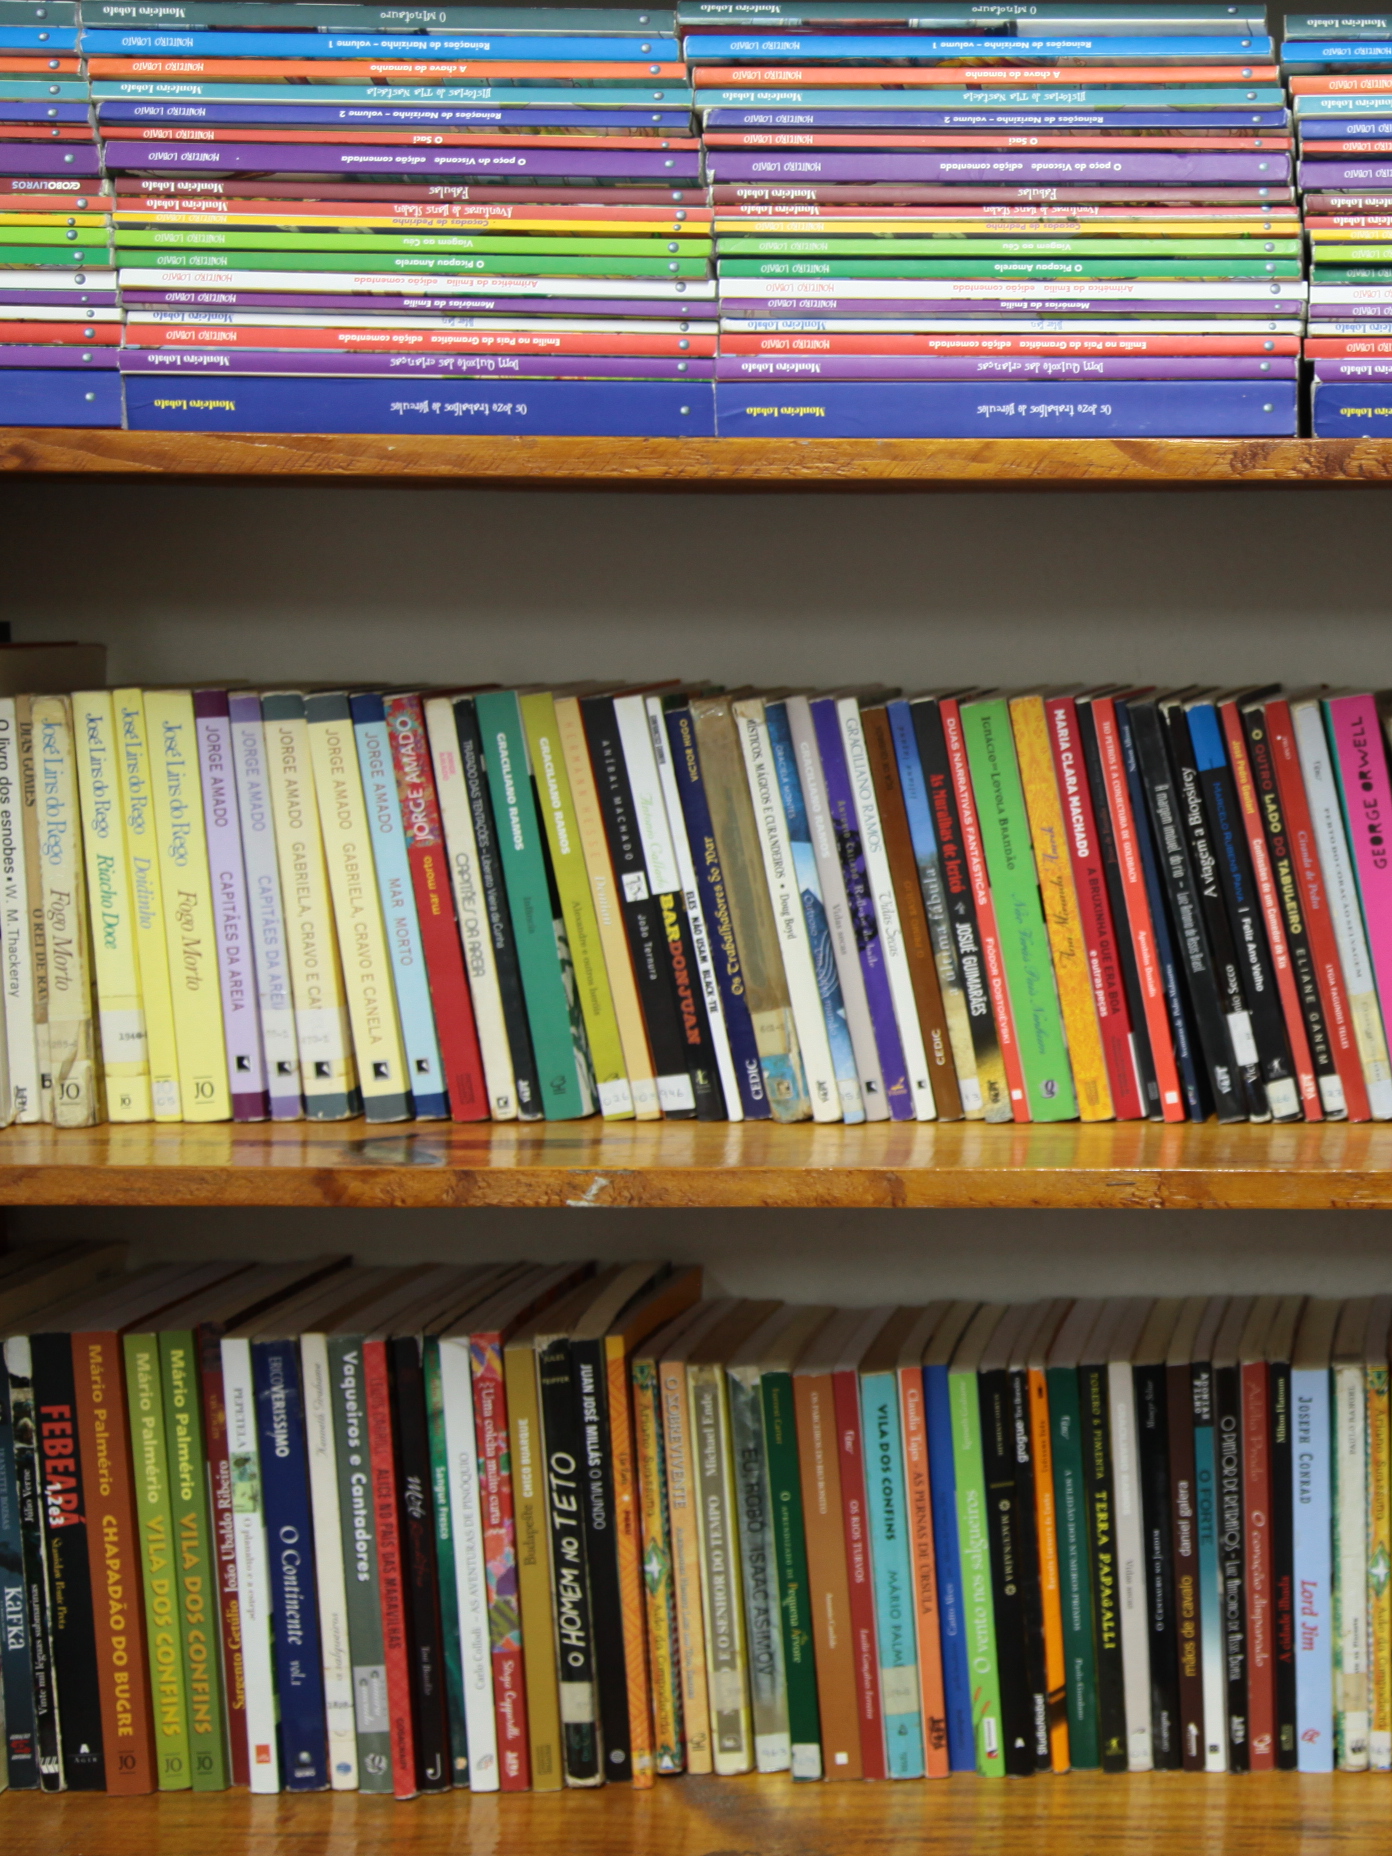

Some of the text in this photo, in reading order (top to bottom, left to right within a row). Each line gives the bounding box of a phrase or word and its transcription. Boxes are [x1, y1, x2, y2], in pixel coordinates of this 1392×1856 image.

[153, 398, 236, 411] Monteiro Lobato
[1340, 407, 1373, 418] Lobato
[162, 720, 192, 868] José Lins do Rego
[205, 725, 229, 828] JORGE AMADO
[325, 728, 353, 831] JORGE AMADO
[395, 716, 435, 841] JORGE AMADO
[496, 732, 525, 851] GRACILIANO RAMOS
[539, 736, 572, 855] GRACILIANO RAMOS
[679, 718, 699, 783] VICTOR HUGO
[1054, 708, 1090, 858] MARIA CLARA MACHADO
[1255, 744, 1281, 833] OUTRO LADO
[1351, 715, 1388, 870] GEORGE ORWELL
[762, 803, 773, 813] E
[763, 813, 787, 880] CURANDEIROS
[947, 718, 987, 905] DUAS NARRATIVAS FANTÁSTICAS
[175, 889, 204, 992] Fogo Morto
[219, 871, 245, 1013] CAPITÃES DA AREIA
[353, 921, 373, 969] CRAVO
[388, 878, 414, 967] MAR MORTO
[1277, 858, 1303, 934] TABULEIRO
[361, 974, 375, 983] E
[956, 922, 987, 1017] JOSUÉ GUIMARÃES
[1241, 917, 1265, 992] Feliz Ano Velho
[1295, 947, 1329, 1065] ELIANE GANEM
[362, 986, 384, 1046] CANELA
[745, 1059, 764, 1101] CEDIC
[88, 1344, 112, 1498] Mário Palmério
[169, 1348, 194, 1502] Mário Palmério
[580, 1363, 595, 1393] JUAN
[583, 1394, 598, 1422] JOSÉ
[340, 1350, 372, 1582] Vaqueiros e Cantadores
[878, 1403, 897, 1543] VILA DOS CONFINS
[1298, 1395, 1313, 1505] JOSEPH CONRAD
[551, 1450, 586, 1668] O HOMEM NO TETO
[1094, 1490, 1117, 1650] TERRA PAPAGALLI
[1176, 1480, 1193, 1557] daniel galera
[102, 1514, 134, 1738] CHAPADÃO DO BUGRE
[179, 1512, 214, 1736] VILA DOS CONFINS
[966, 1488, 992, 1674] O vento nos salgueiros
[1179, 1574, 1197, 1677] mãos de cavalo
[1301, 1579, 1320, 1652] Lord Jim
